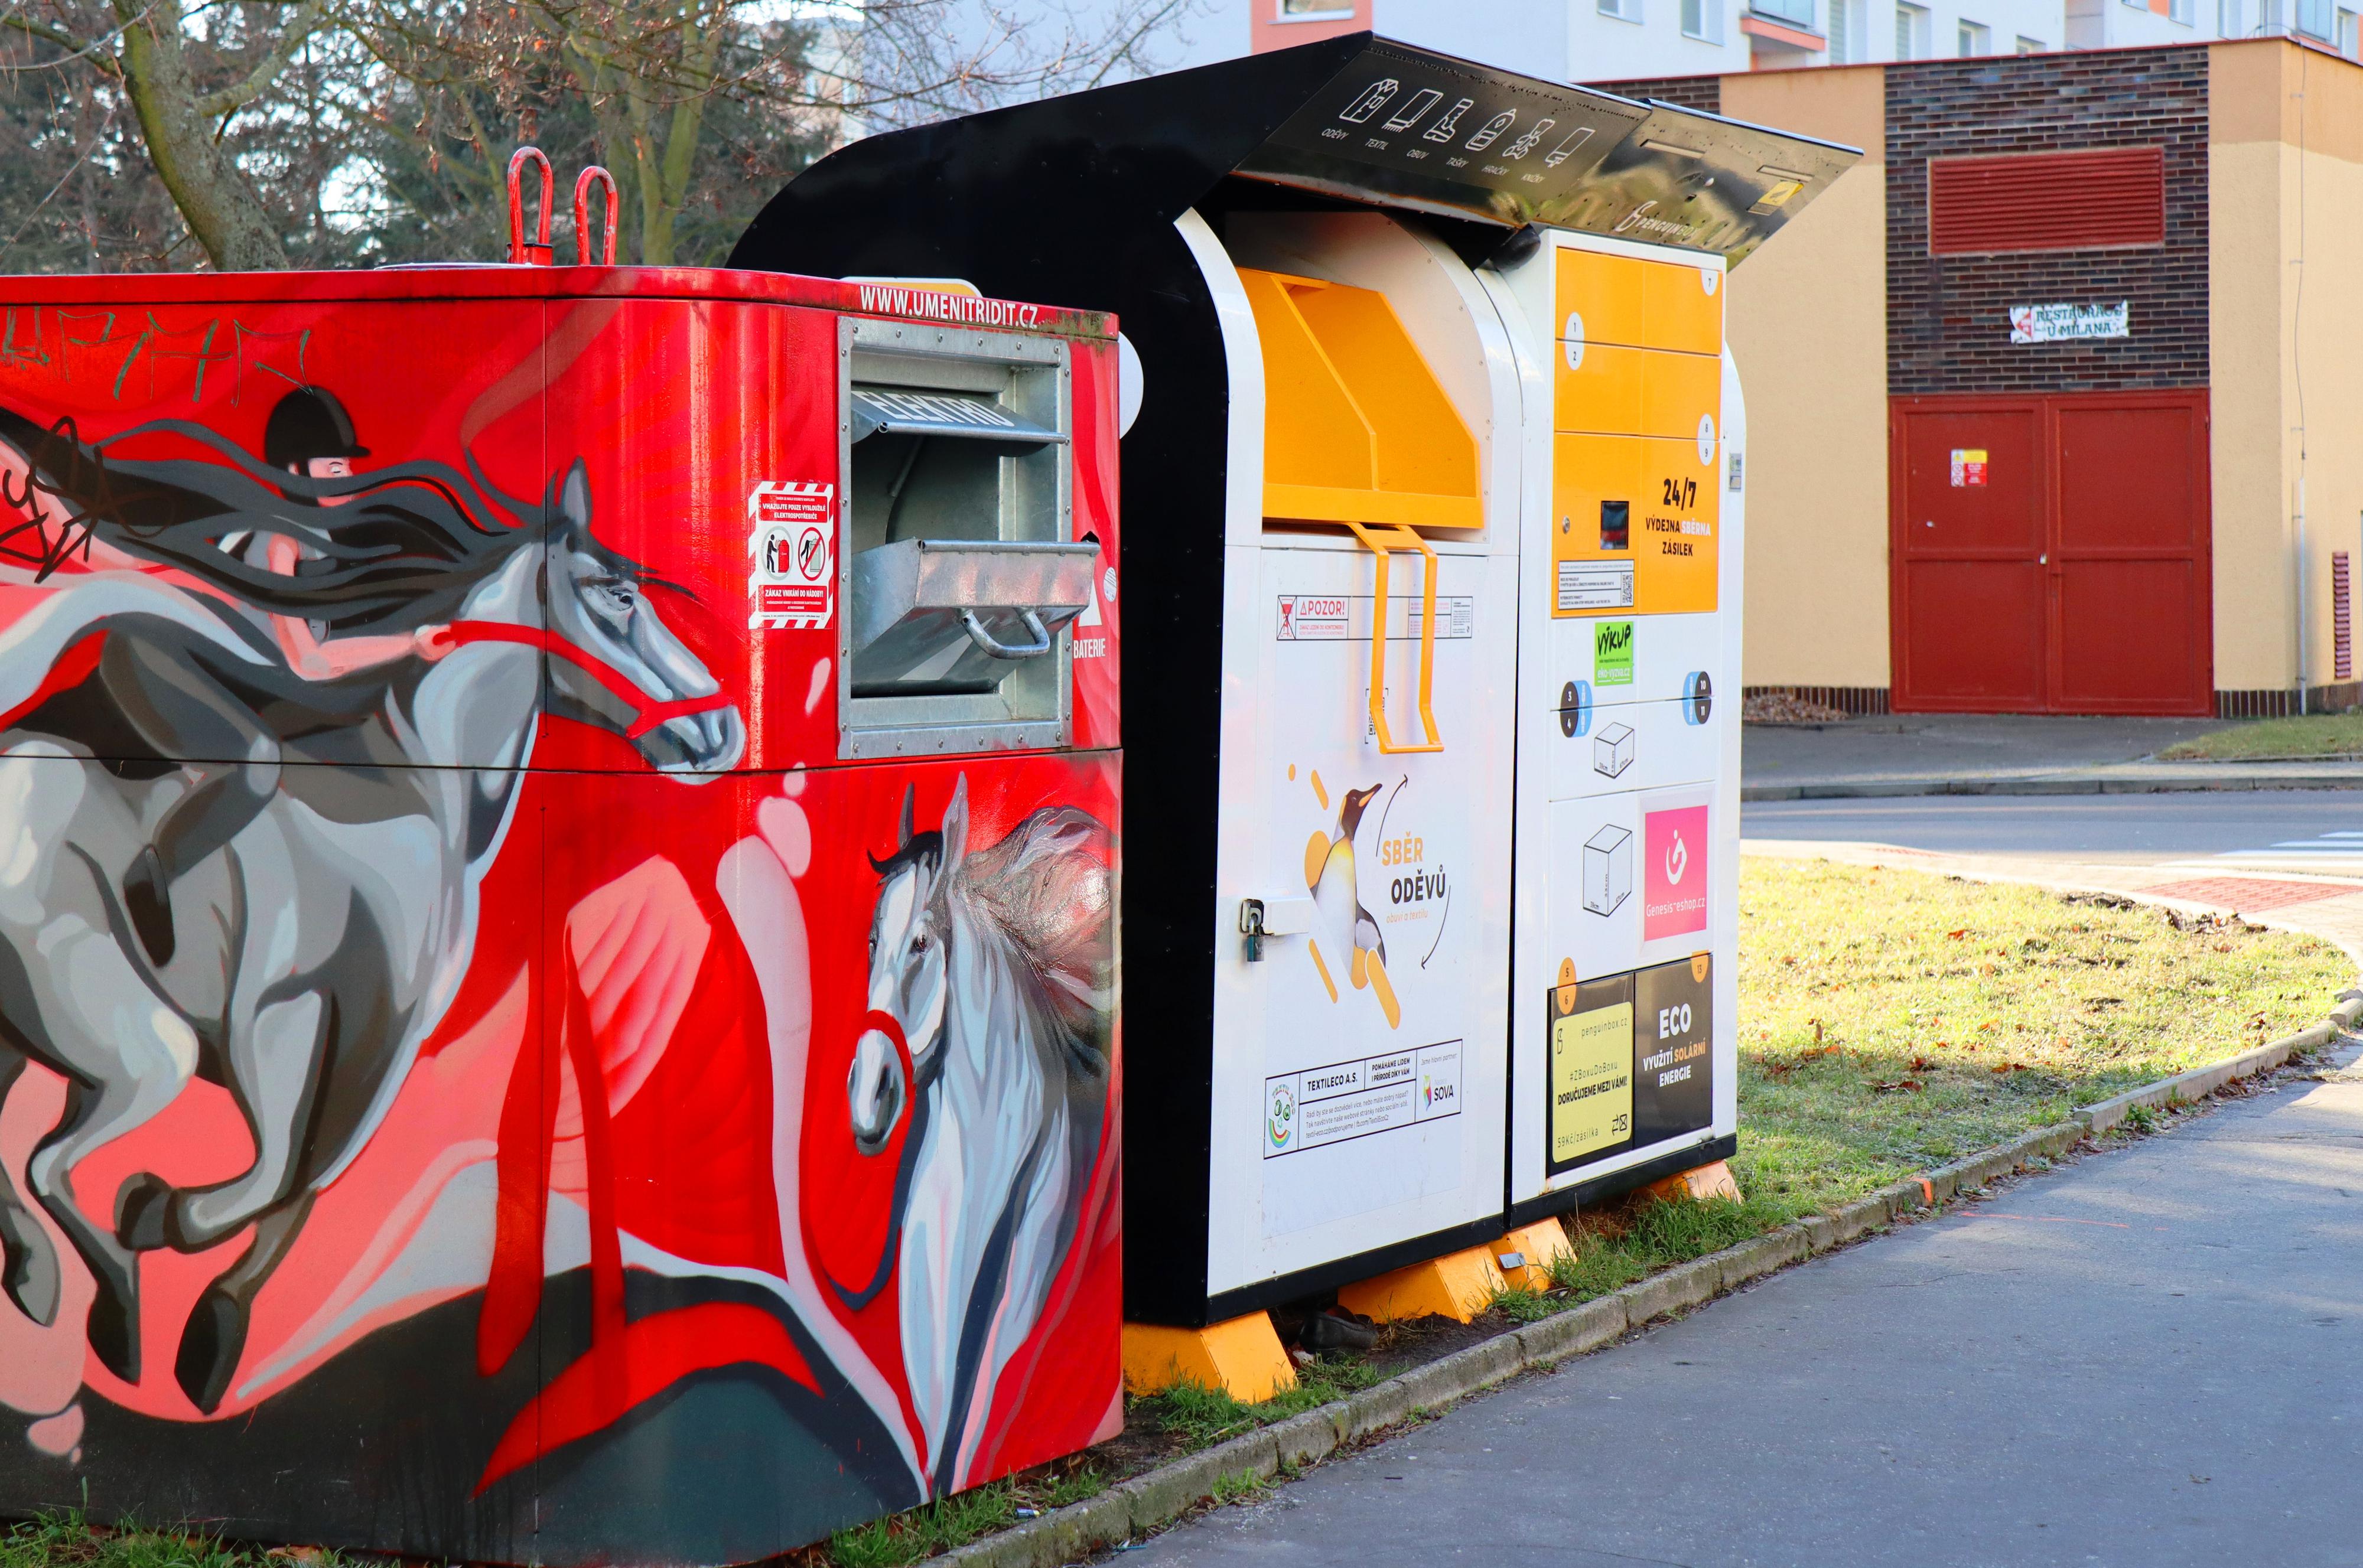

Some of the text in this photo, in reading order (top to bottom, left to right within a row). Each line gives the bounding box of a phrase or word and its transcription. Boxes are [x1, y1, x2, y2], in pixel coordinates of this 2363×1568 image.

[1321, 128, 1349, 140] ODĚVY
[1365, 138, 1389, 150] TEXTIL
[1406, 149, 1429, 160] OBUV
[1446, 157, 1469, 168] TAŠKY
[1482, 164, 1510, 176] HRAČKY
[1707, 278, 1711, 287] 7
[860, 285, 1038, 328] WWW.UMENITRIDIT.CZ
[2047, 322, 2111, 337] U MILANA
[1573, 351, 1577, 361] 2
[851, 390, 1014, 426] ELEKTRO
[1704, 448, 1708, 457] 9
[1664, 477, 1697, 511] 24/7
[774, 511, 818, 520] ELEKTROSPOTŘEBIČE
[1646, 514, 1711, 536] VÝDEJNA SBĚRNA
[1662, 539, 1693, 556] ZÁSILEK
[765, 588, 782, 597] ZÁKAZ
[783, 588, 799, 598] VNIKÁNÍ
[806, 588, 824, 598] NÁDOBY!
[1308, 600, 1345, 615] POZOR!
[1597, 624, 1630, 656] VÝKUP
[1073, 638, 1106, 659] BATERIE
[1700, 680, 1706, 690] 10
[1568, 691, 1572, 702] 3
[1700, 706, 1705, 716] 11
[1567, 718, 1571, 729] 4
[1382, 831, 1423, 866] SBĚR
[1391, 864, 1446, 904] ODĚVŮ
[1646, 898, 1705, 917] Genesis-eshop.cz
[1386, 912, 1403, 924] obuvi
[1410, 908, 1428, 920] textilu
[1565, 967, 1569, 977] 5
[1697, 964, 1702, 974] 13
[1564, 995, 1568, 1005] 6
[1581, 1018, 1628, 1039] penguinbox.cz
[1659, 1003, 1691, 1039] ECO
[1643, 1038, 1706, 1071] VYUŽITÍ SOLÁRNÍ
[1372, 1057, 1410, 1071] POMÁHÁME LIDEM
[1570, 1061, 1617, 1081] #ZBoxuDoBoxu
[1373, 1070, 1391, 1081] PŘÍRODĚ
[1391, 1068, 1401, 1078] DÍKY
[1401, 1067, 1410, 1075] VÁM
[1659, 1065, 1691, 1087] ENERGIE
[1307, 1073, 1358, 1091] TEXTILECO A.S.
[1434, 1084, 1454, 1101] SOVA
[1558, 1075, 1628, 1106] DORUČUJEME MEZI VÁMI!
[1557, 1127, 1598, 1148] 59Kč/zásilka
